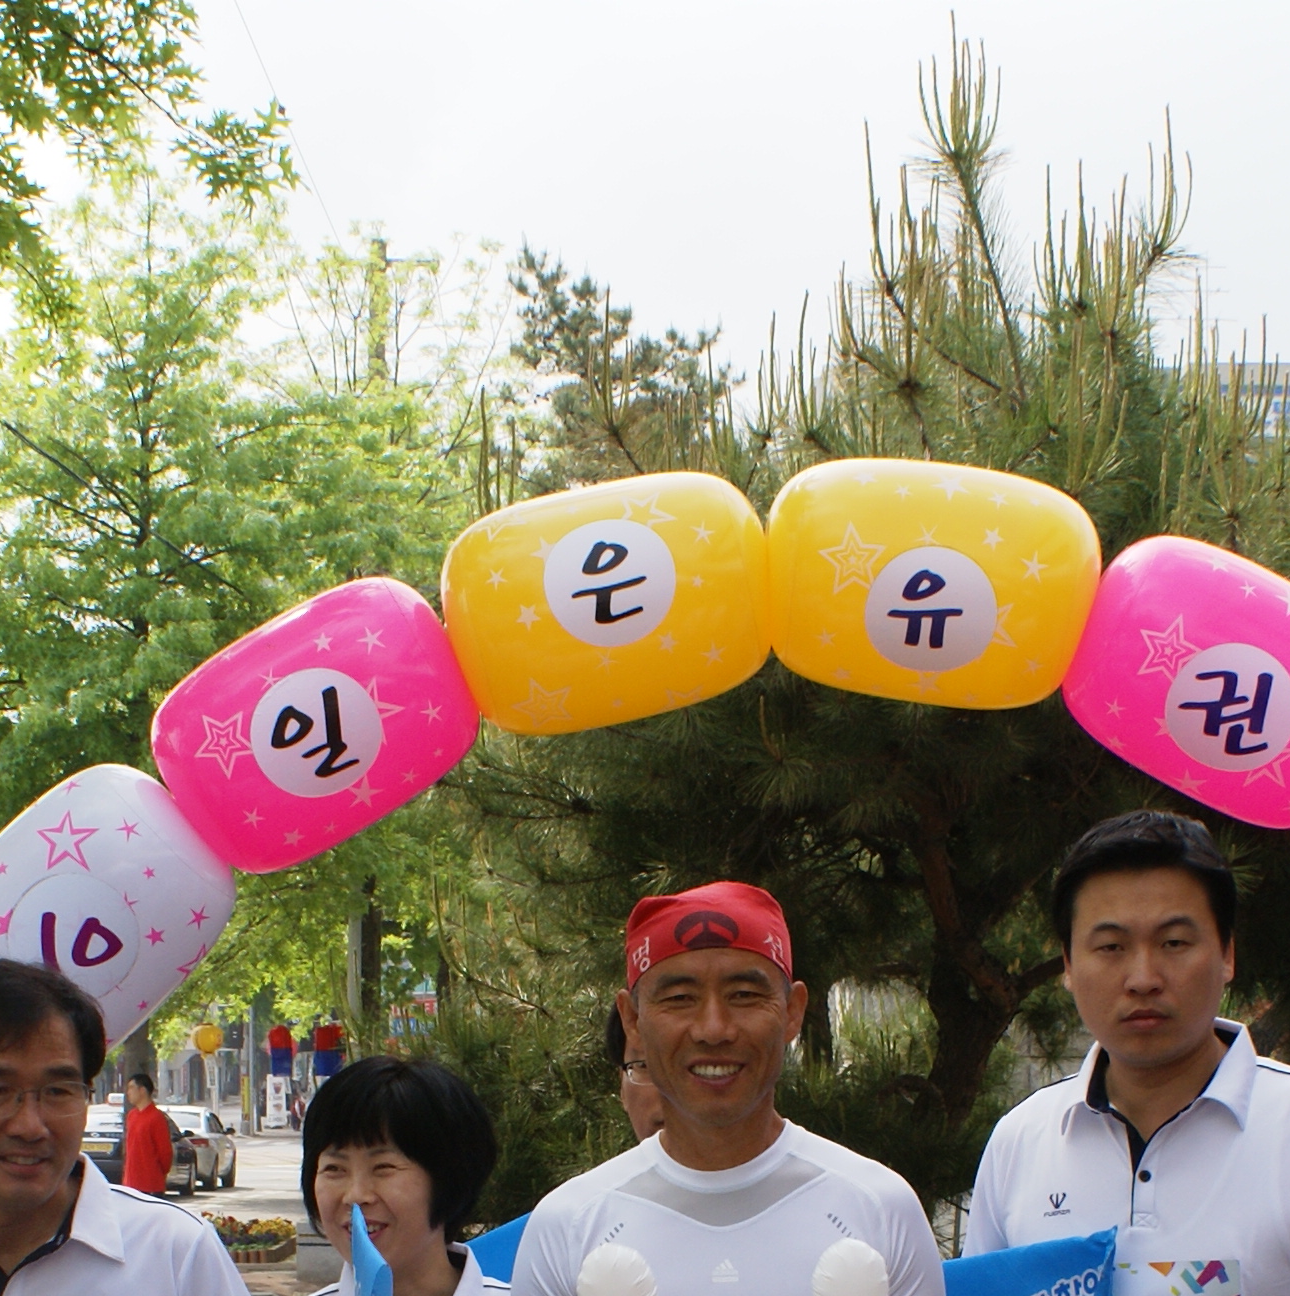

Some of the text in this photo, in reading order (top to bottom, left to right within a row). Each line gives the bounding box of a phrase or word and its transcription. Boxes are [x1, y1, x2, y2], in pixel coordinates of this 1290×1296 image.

[270, 686, 360, 778] 일
[571, 541, 647, 624] 은
[889, 567, 964, 650] 유
[1178, 669, 1275, 757] 권
